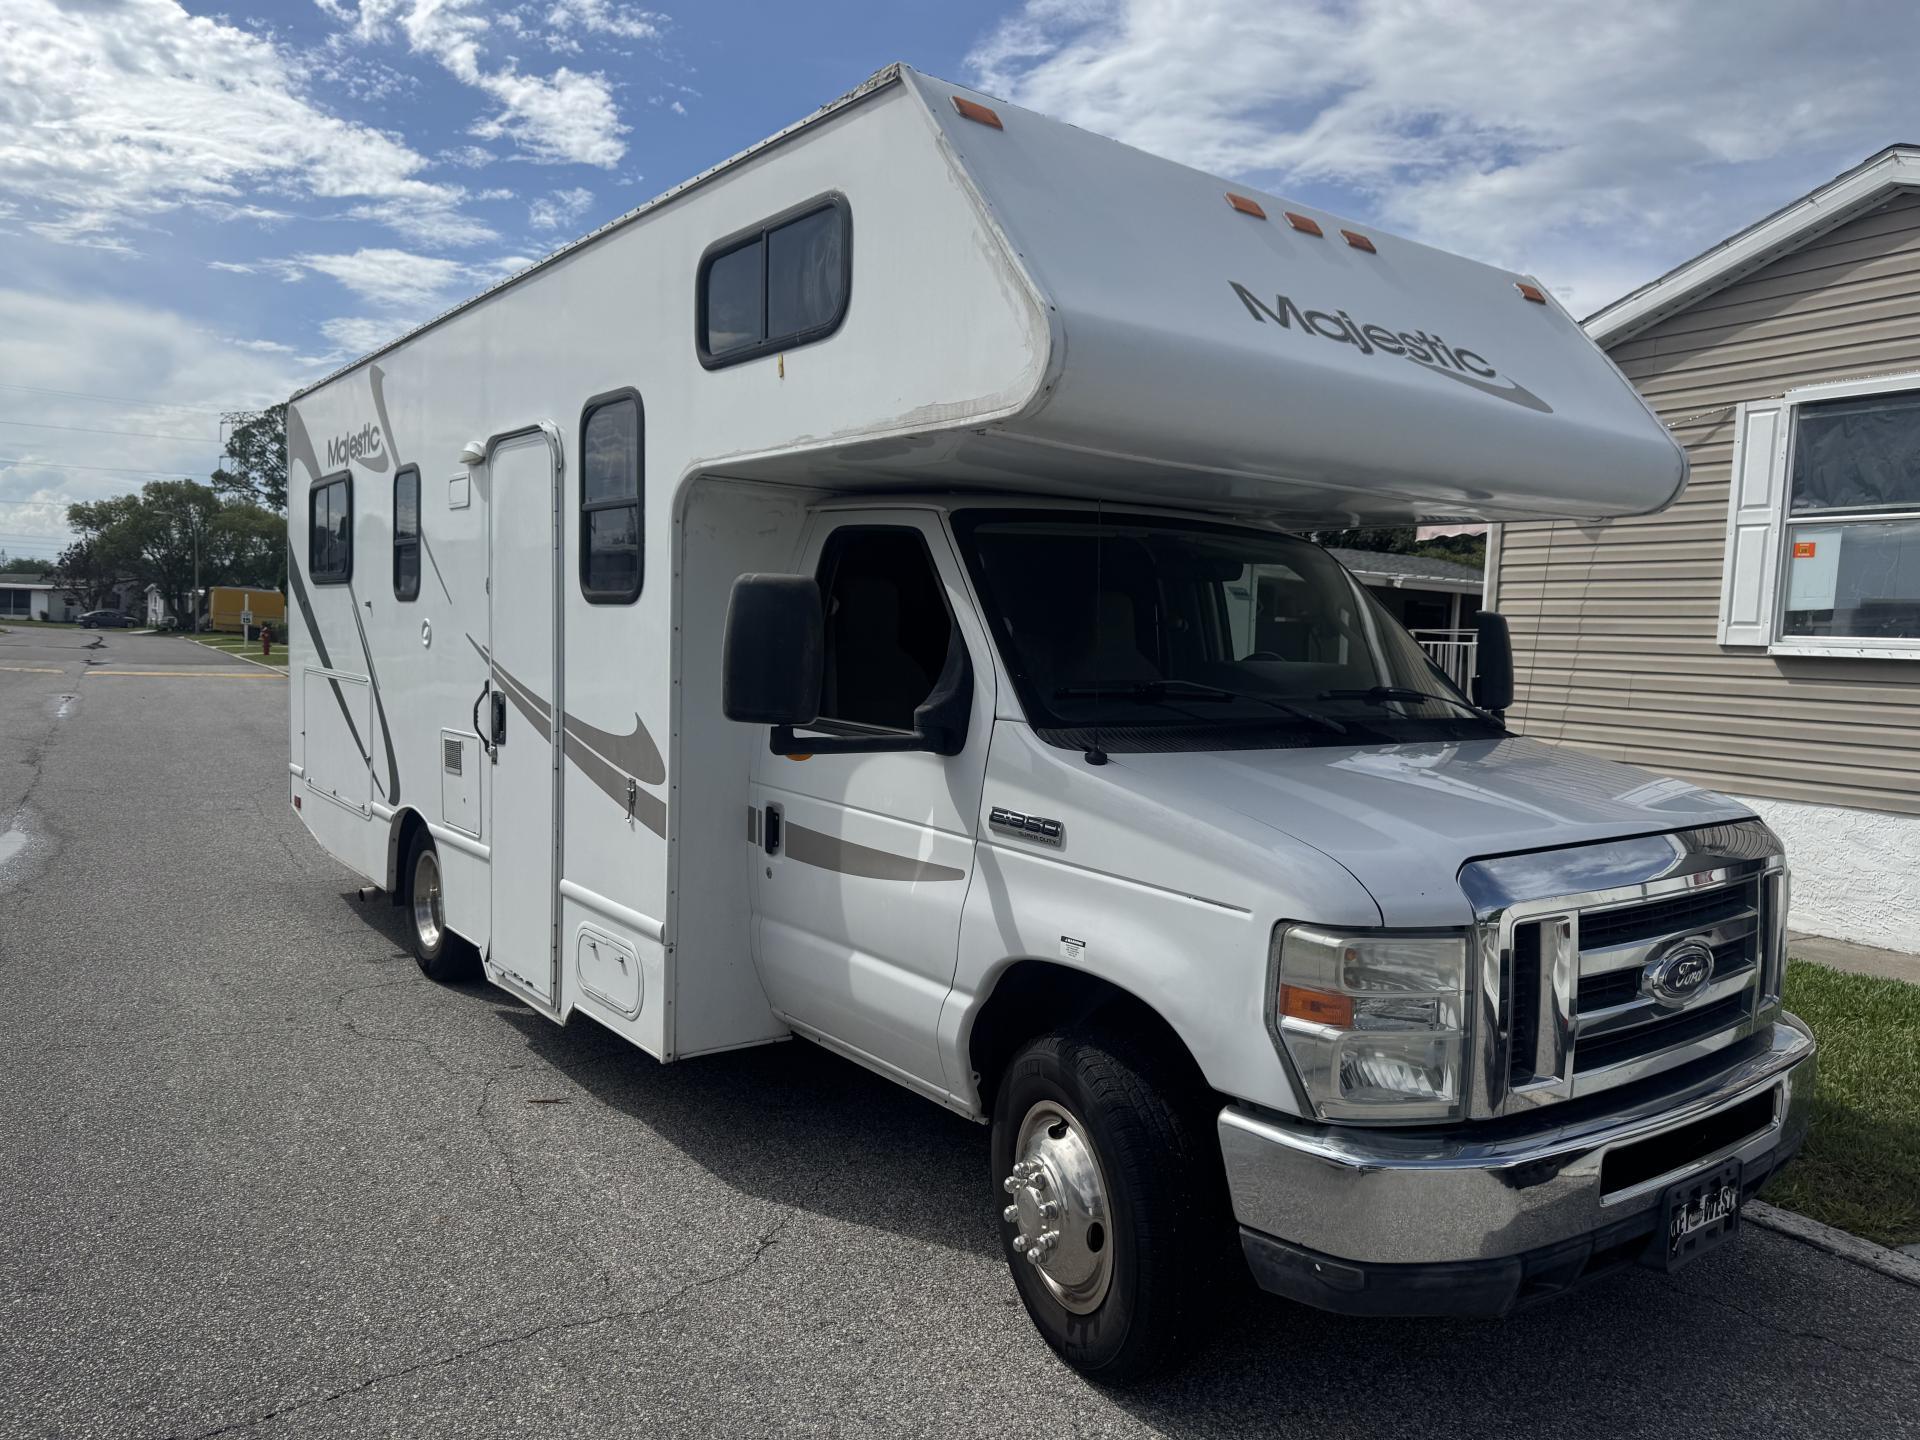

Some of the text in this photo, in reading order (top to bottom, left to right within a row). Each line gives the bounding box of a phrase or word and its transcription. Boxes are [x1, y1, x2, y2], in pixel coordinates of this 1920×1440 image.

[1227, 280, 1496, 378] Majestic
[327, 422, 380, 468] Majestic
[1675, 961, 1703, 988] Ford
